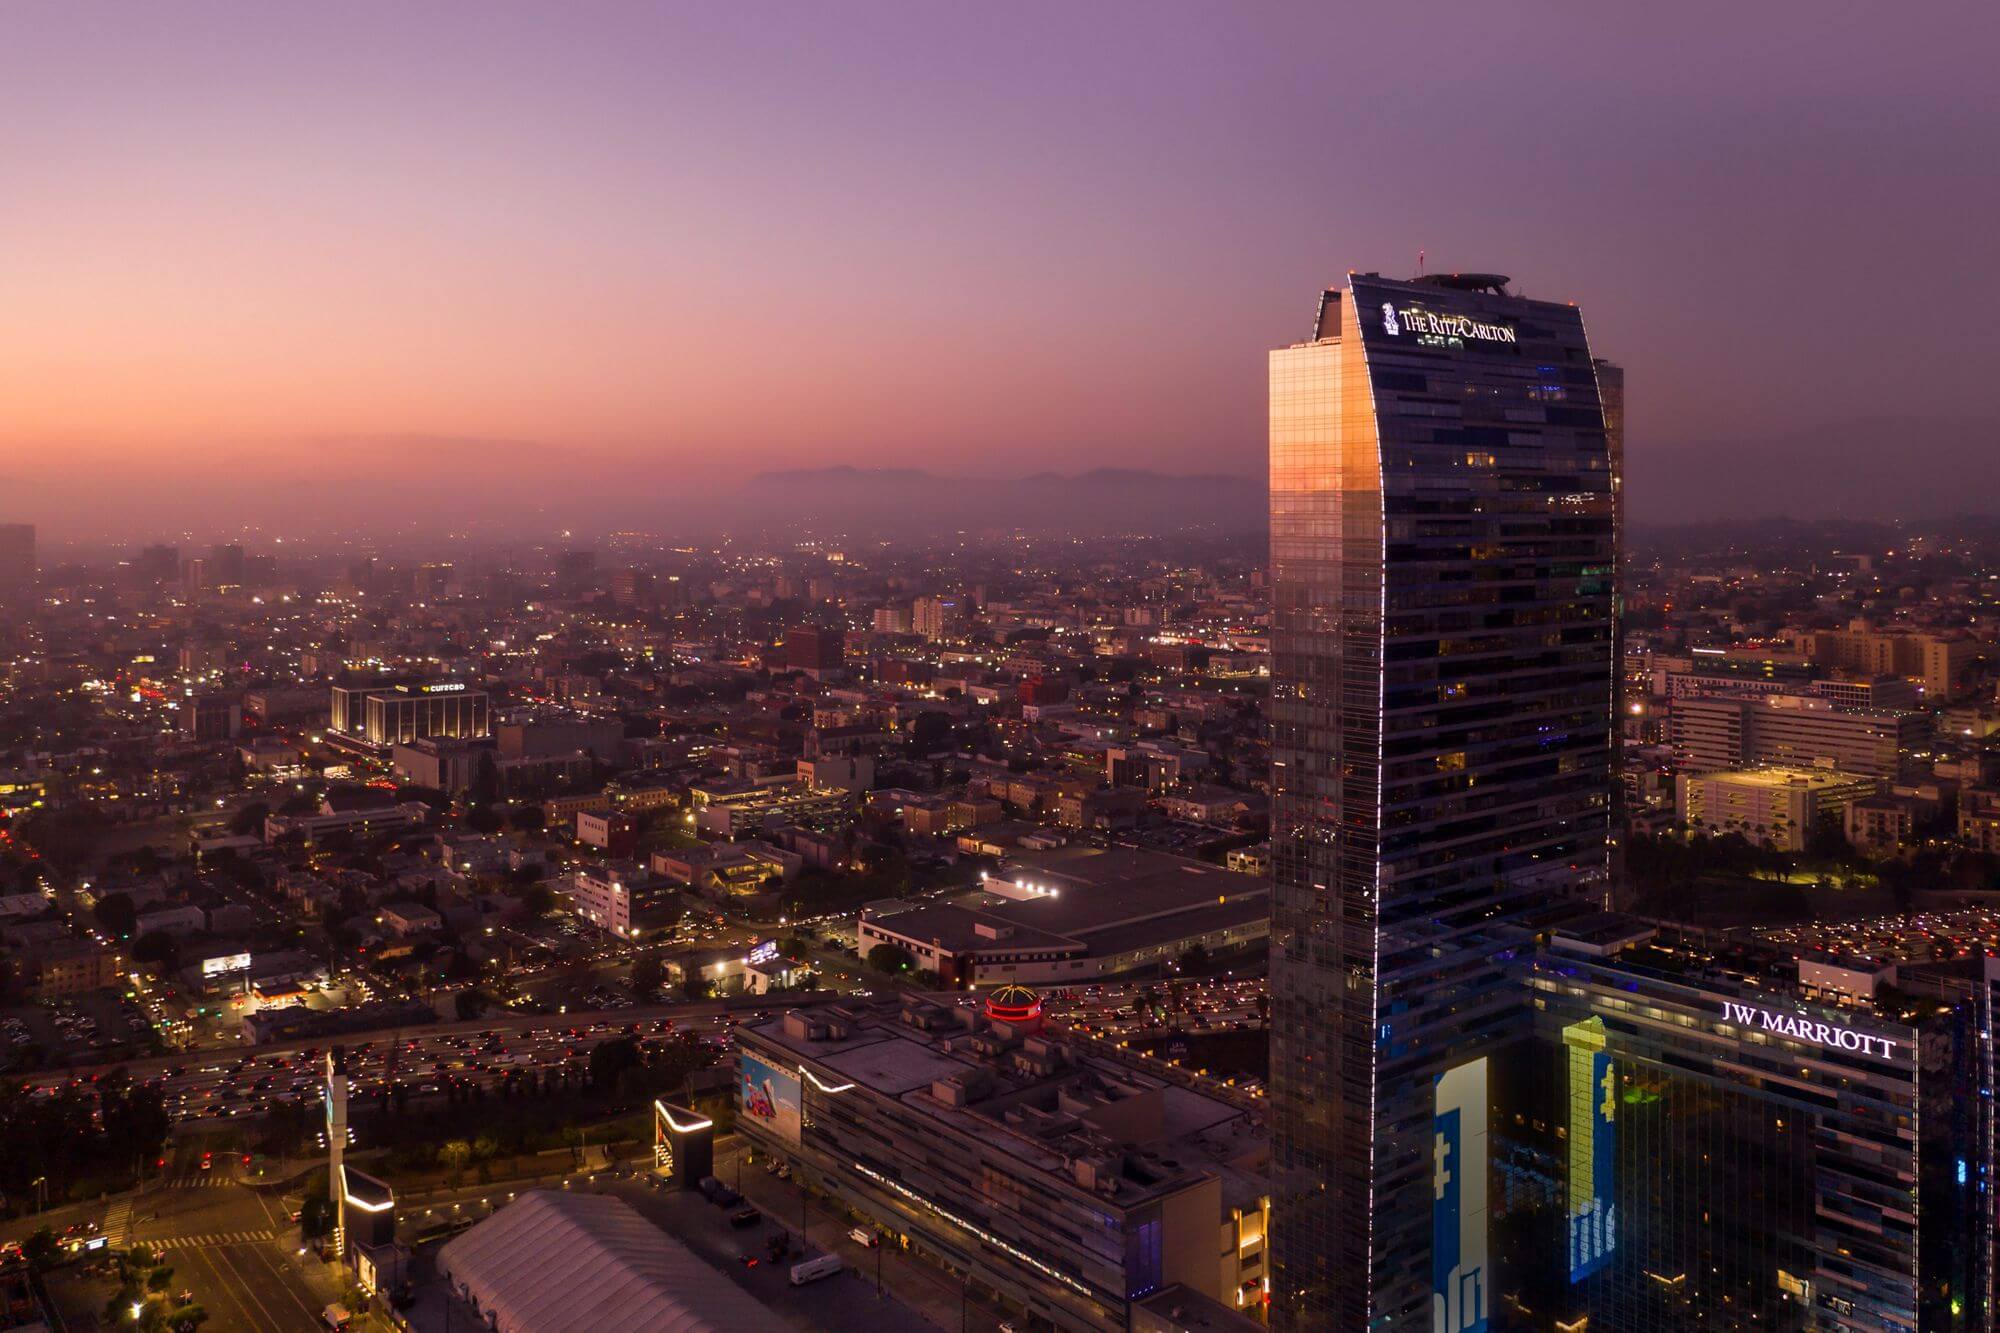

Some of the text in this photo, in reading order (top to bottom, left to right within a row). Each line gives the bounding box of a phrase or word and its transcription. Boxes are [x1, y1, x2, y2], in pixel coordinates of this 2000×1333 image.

[1399, 310, 1516, 343] THE RITZ-CARLTON
[1722, 1001, 1897, 1060] JW MARRIOTT
